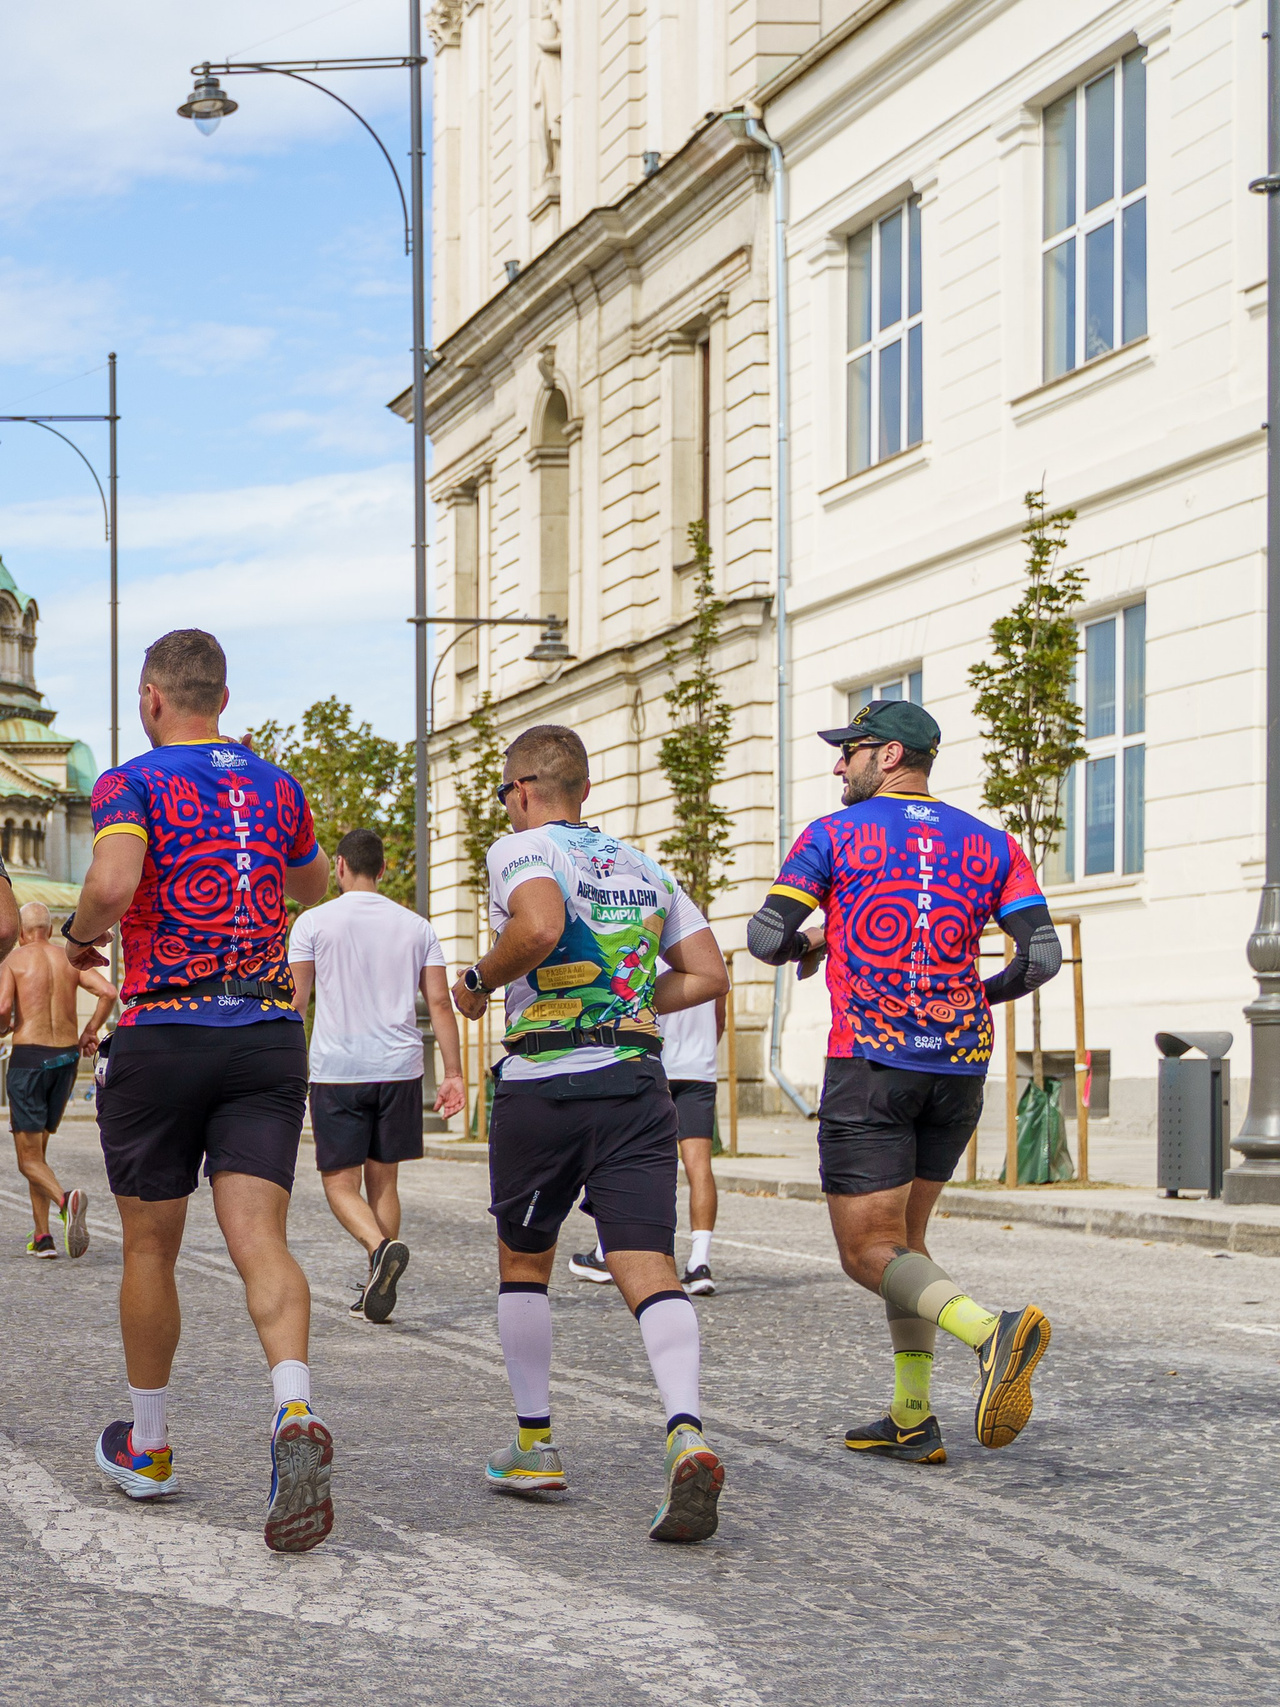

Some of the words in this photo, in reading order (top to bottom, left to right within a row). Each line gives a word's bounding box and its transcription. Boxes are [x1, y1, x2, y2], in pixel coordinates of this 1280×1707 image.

[228, 789, 251, 892] ULTRA
[509, 855, 530, 872] РЪБА
[914, 837, 933, 929] ULTRA
[532, 1004, 547, 1017] НЕ
